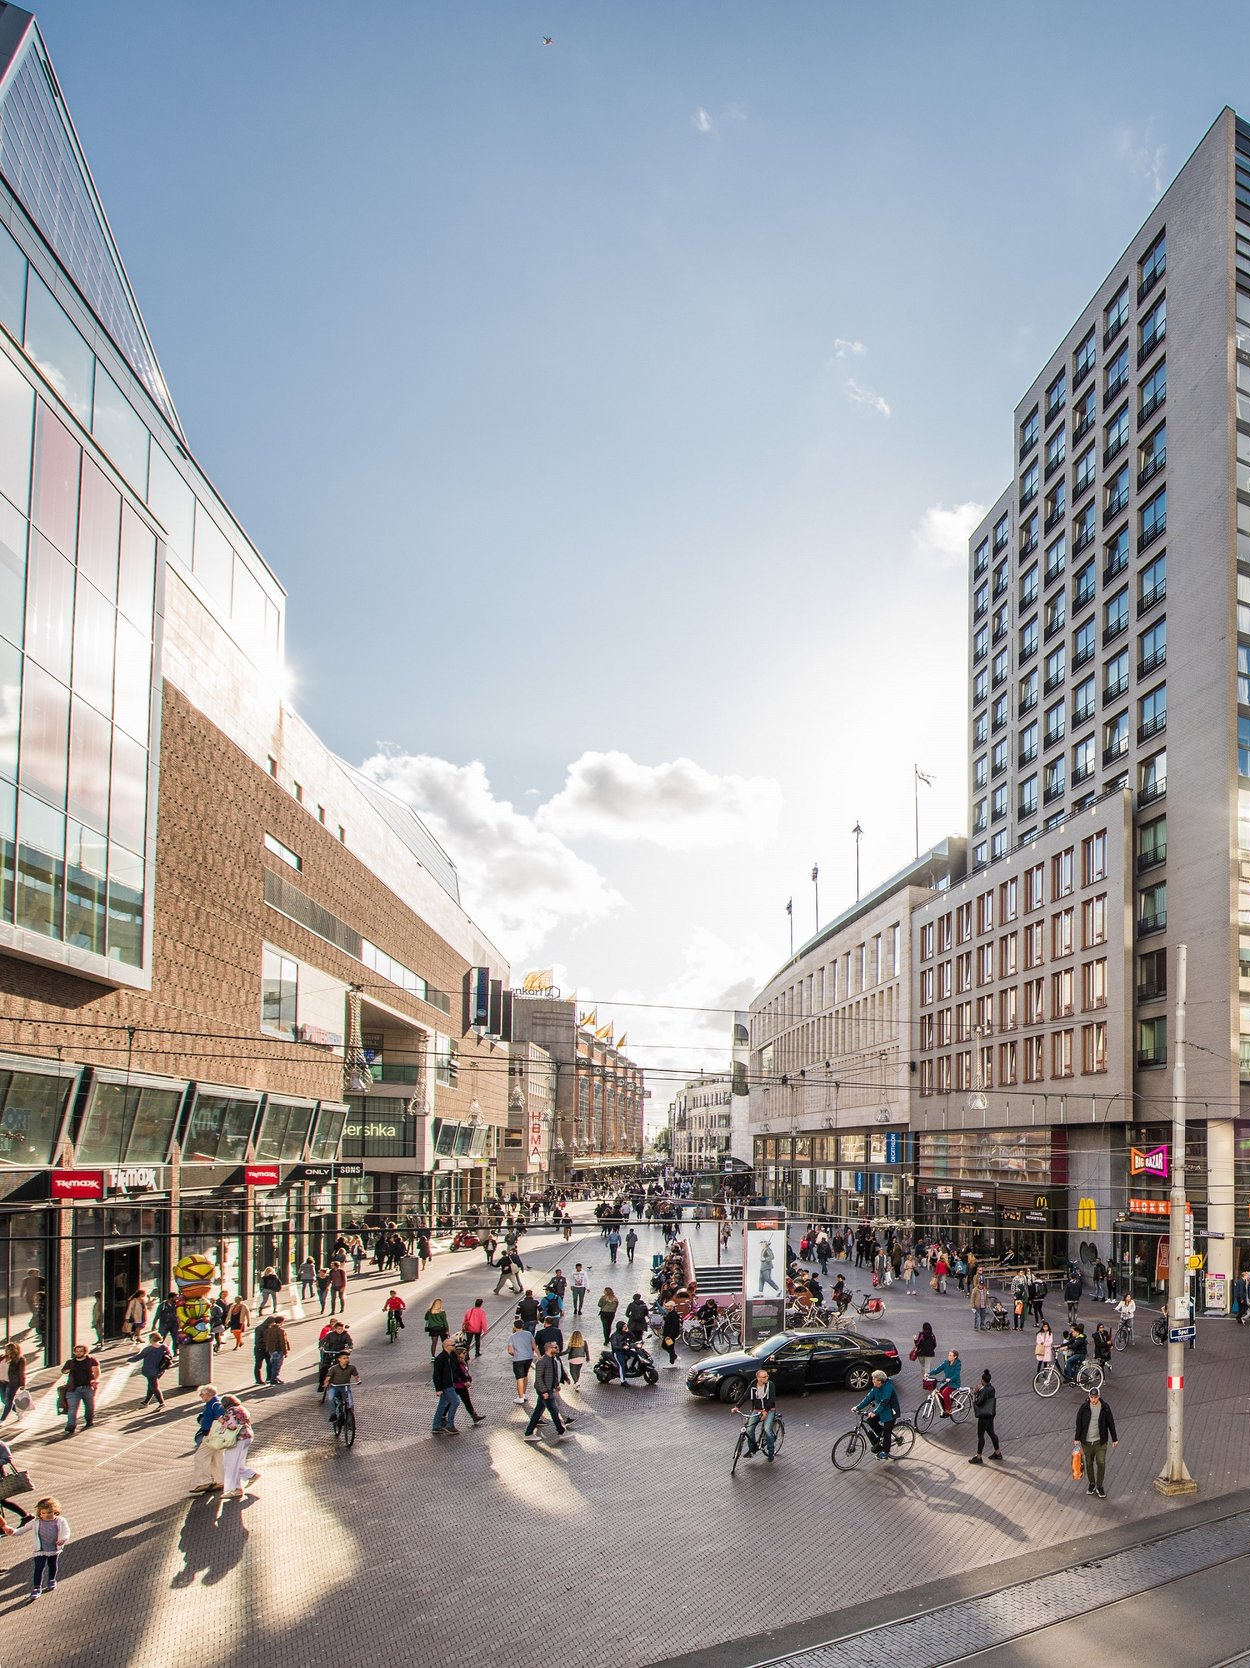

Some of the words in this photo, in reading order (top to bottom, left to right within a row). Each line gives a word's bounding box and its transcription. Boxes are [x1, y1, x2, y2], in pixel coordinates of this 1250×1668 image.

[531, 1111, 541, 1157] HEMA
[1135, 1155, 1145, 1169] BIG
[1145, 1153, 1163, 1170] BAZAR
[305, 1168, 331, 1176] ONLY
[340, 1165, 361, 1174] SONS
[1177, 1328, 1189, 1337] Spui
